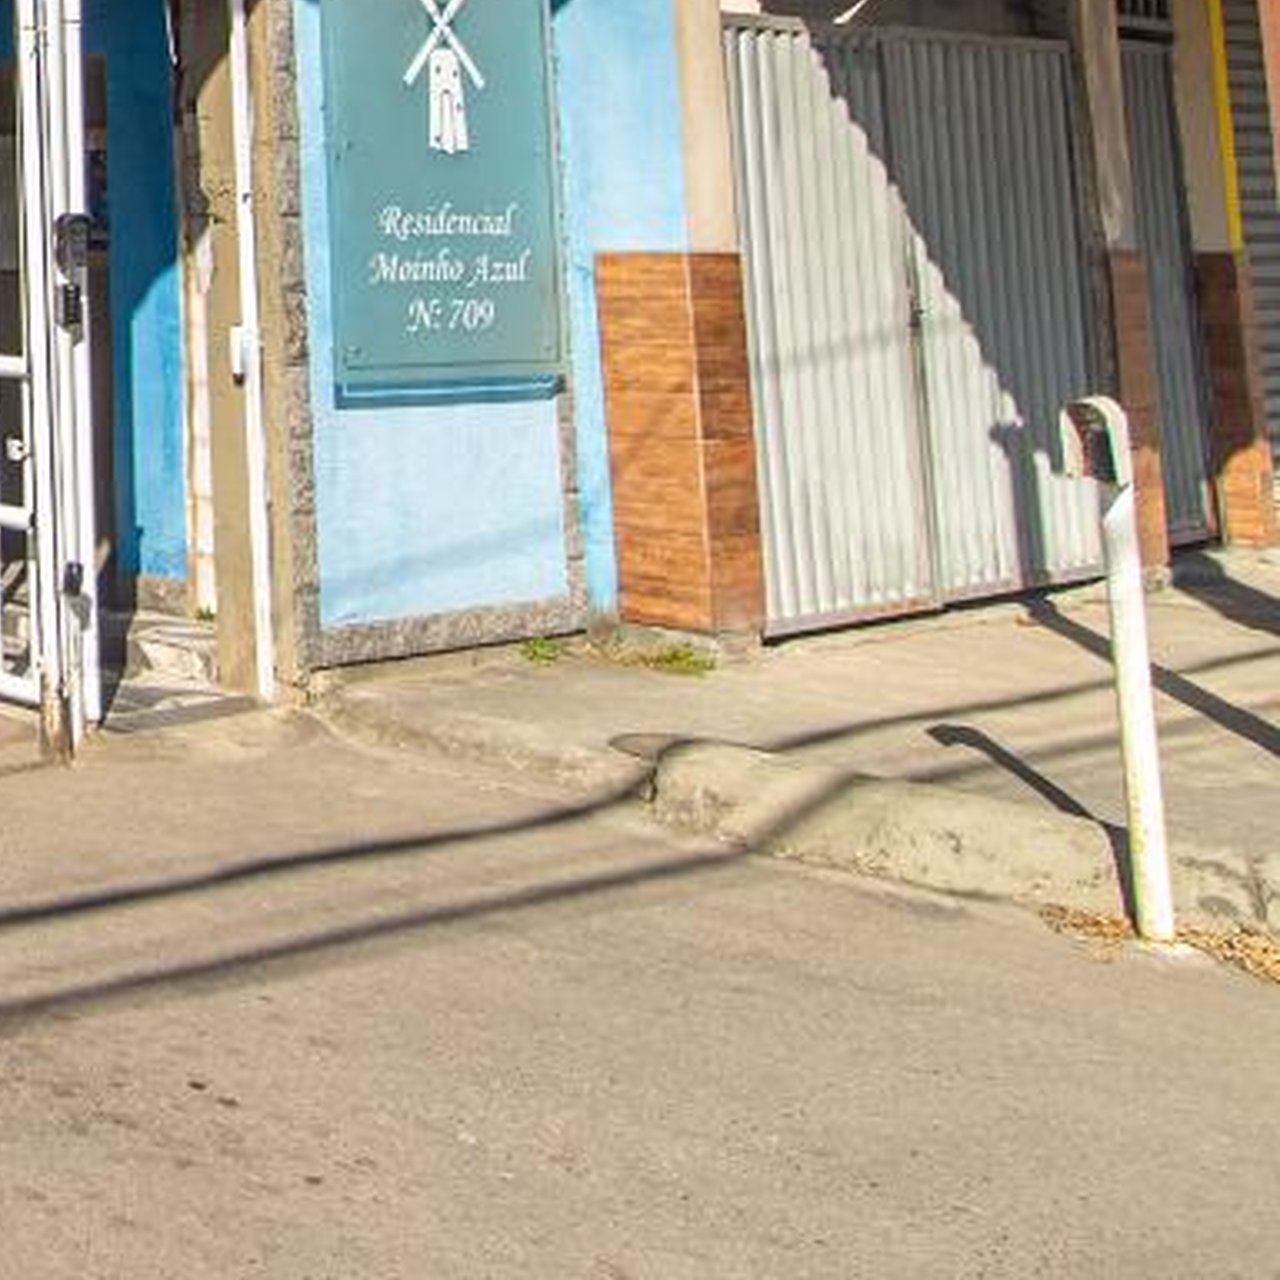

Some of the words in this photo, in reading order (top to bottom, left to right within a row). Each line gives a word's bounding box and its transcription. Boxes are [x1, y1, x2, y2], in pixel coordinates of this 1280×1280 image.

[378, 201, 519, 242] Residencial
[369, 247, 465, 286] Moinho
[465, 247, 533, 288] Azul
[448, 298, 495, 331] 709
